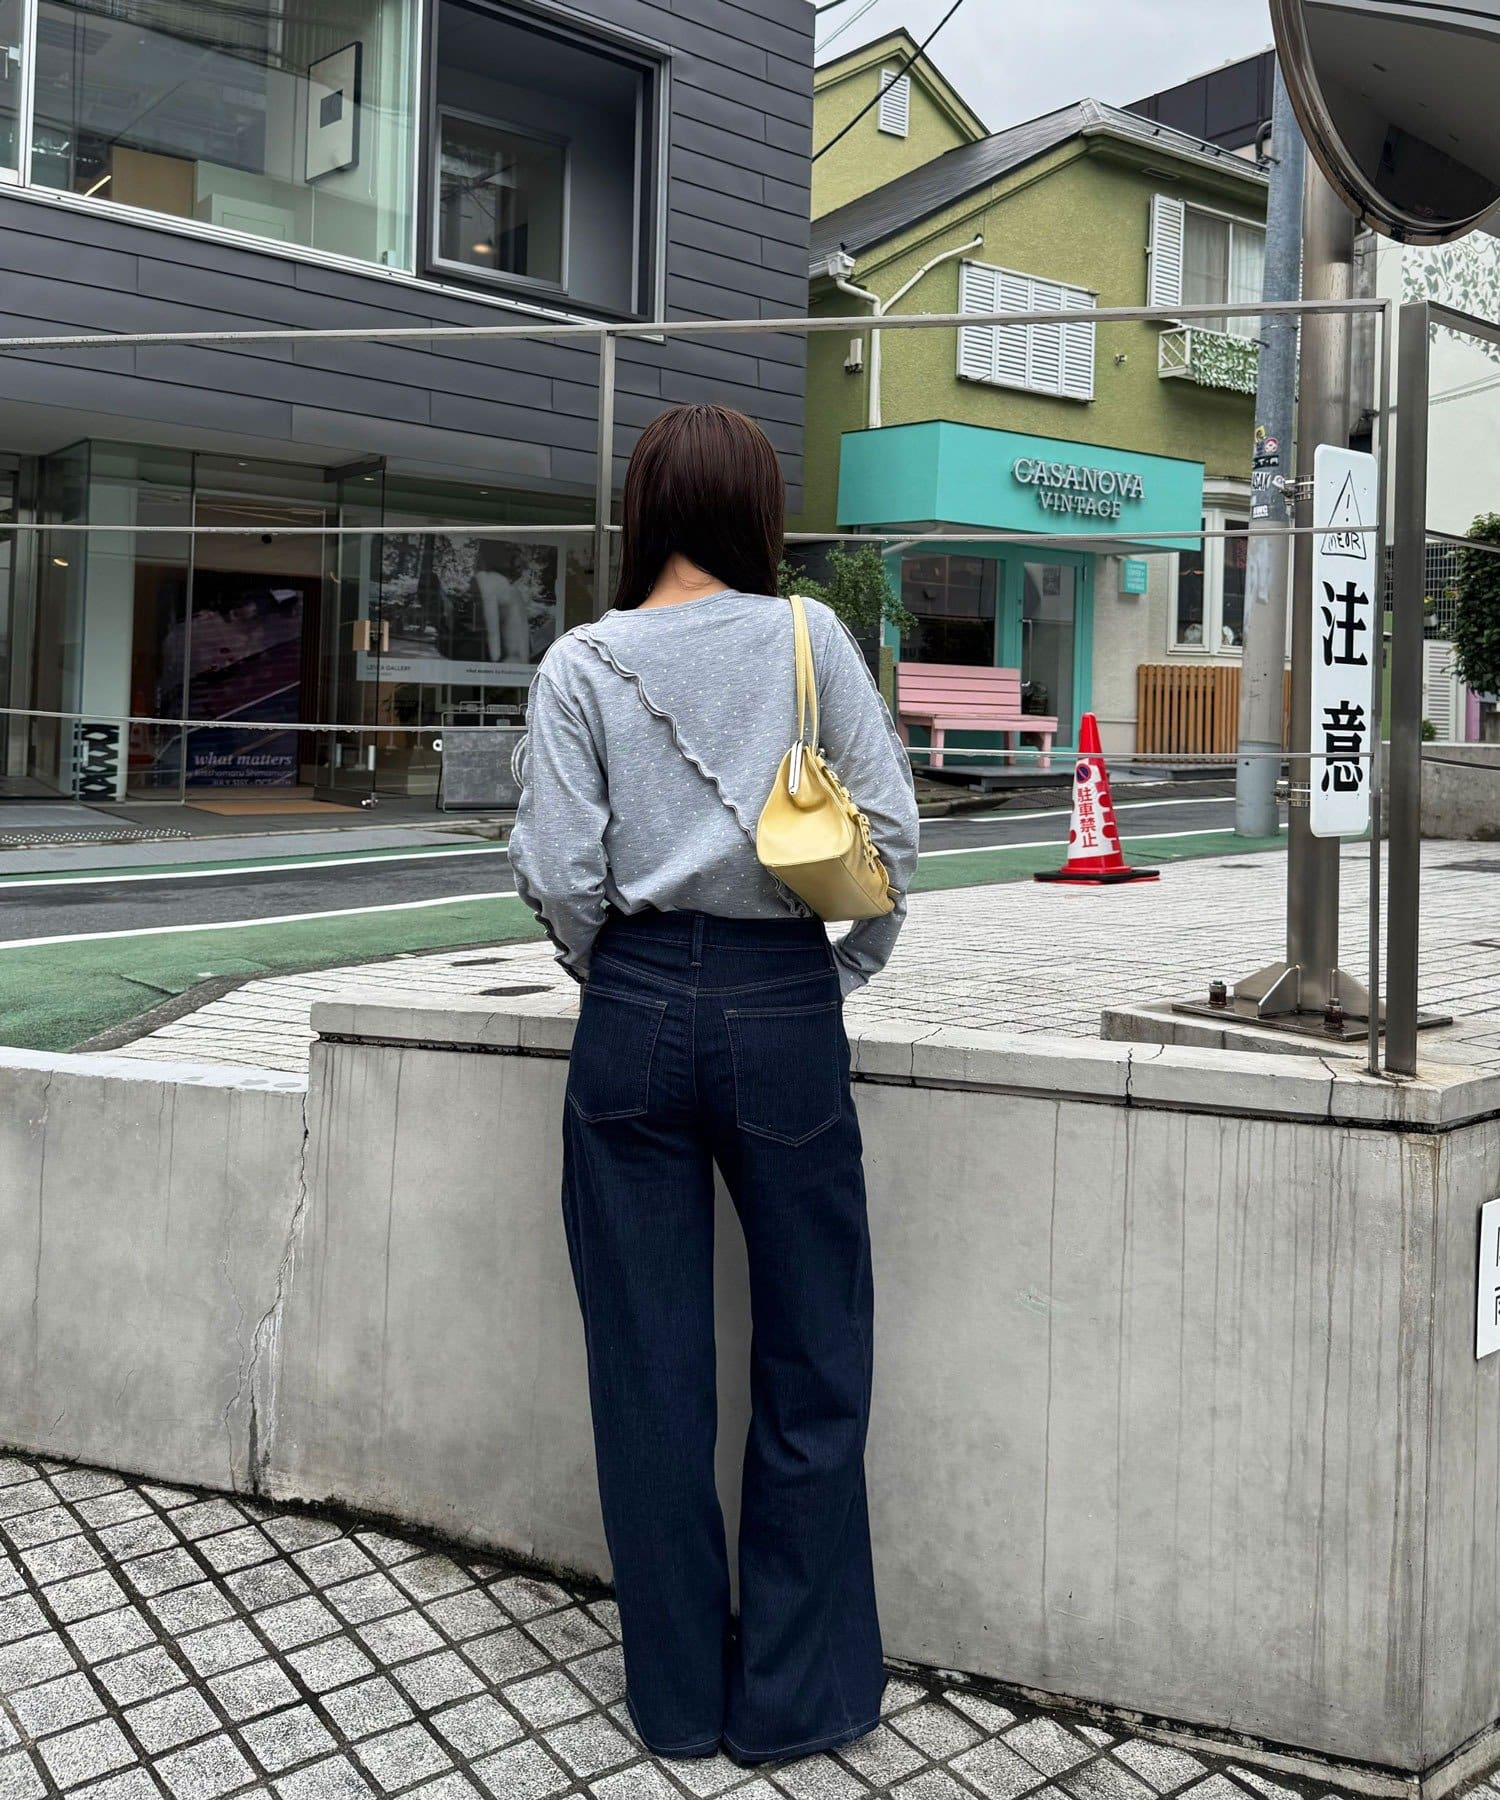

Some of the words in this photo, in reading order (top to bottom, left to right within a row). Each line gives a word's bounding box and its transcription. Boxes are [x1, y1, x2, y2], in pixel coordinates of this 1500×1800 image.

[1013, 457, 1146, 499] CASANOVA
[1040, 490, 1123, 518] VINTAGE
[1320, 580, 1370, 793] 注意
[194, 752, 233, 765] what
[237, 754, 293, 766] matters
[1077, 787, 1099, 849] 駐車禁止
